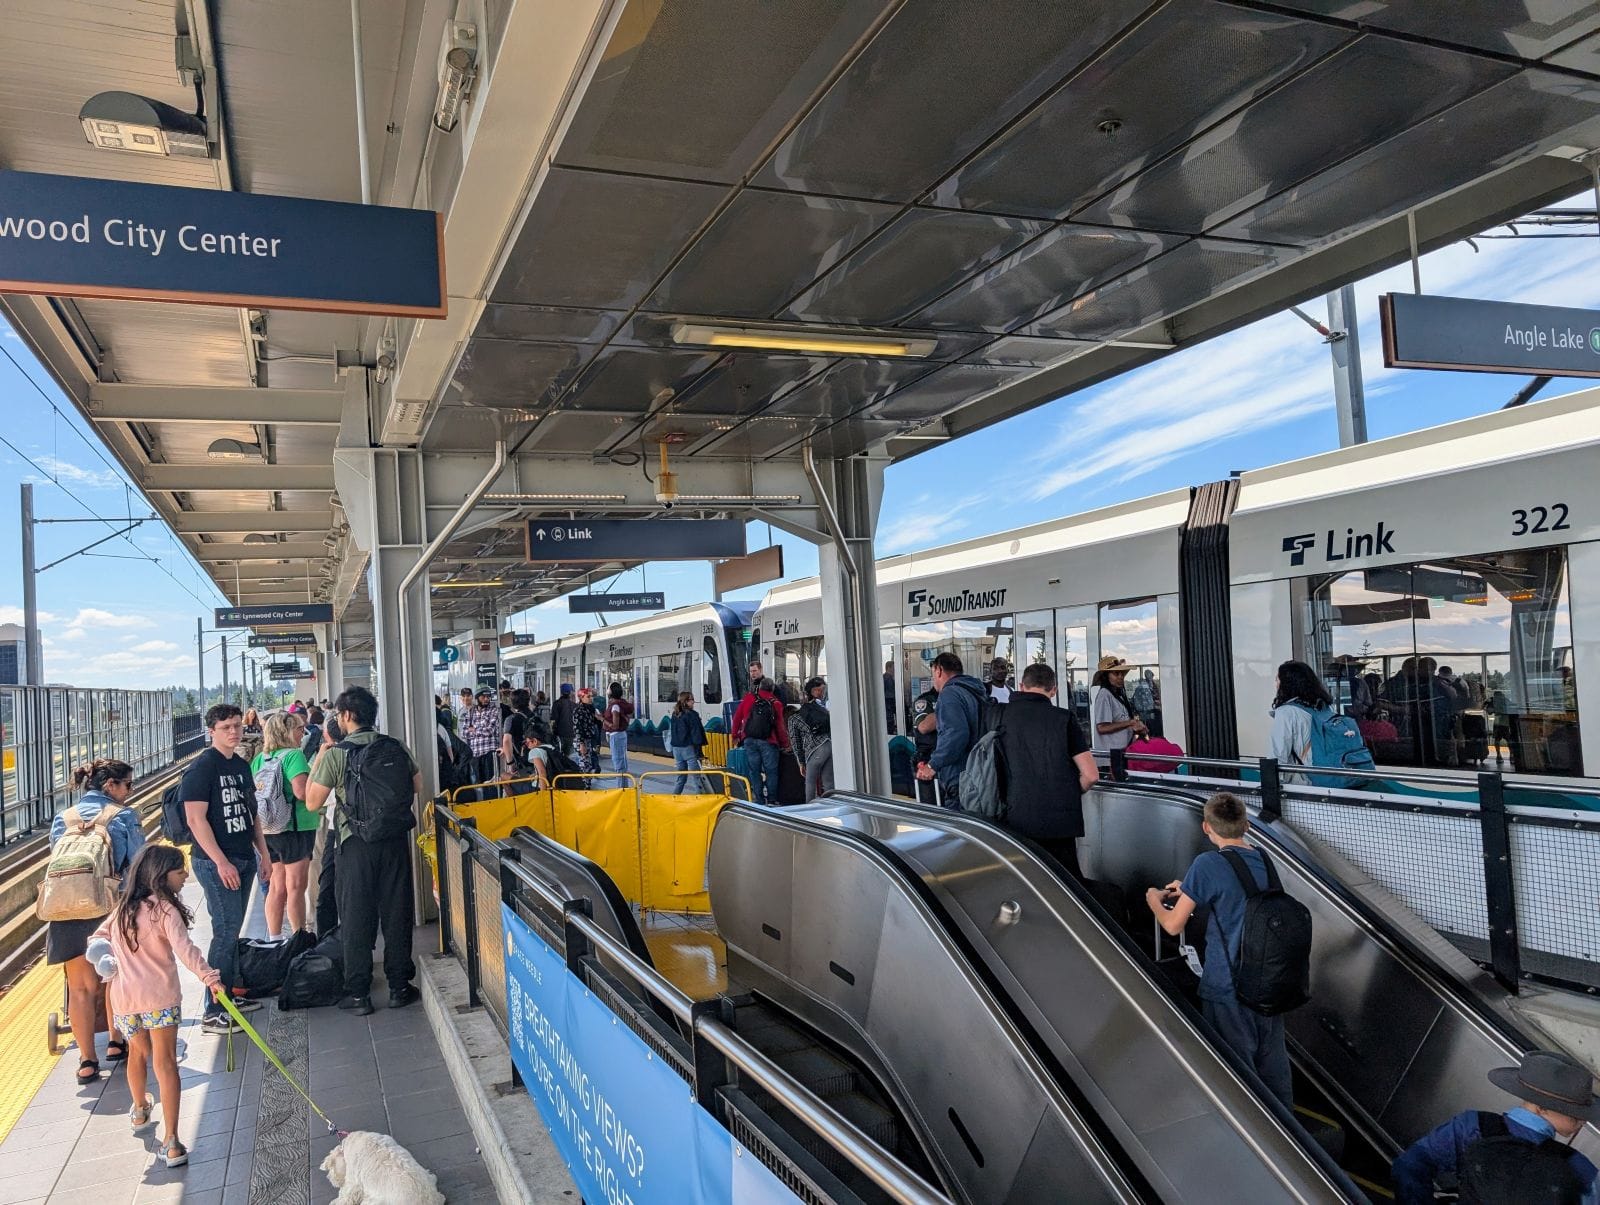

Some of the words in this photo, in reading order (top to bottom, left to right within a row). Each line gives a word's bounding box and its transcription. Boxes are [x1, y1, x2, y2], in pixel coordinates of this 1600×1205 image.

[0, 215, 90, 243] wood
[103, 219, 166, 256] City
[178, 225, 281, 258] Center
[1504, 324, 1547, 351] Angle
[1552, 327, 1584, 350] Lake
[1511, 502, 1571, 536] 322
[568, 528, 593, 541] Link
[1326, 521, 1396, 562] Link
[783, 617, 799, 634] Link
[223, 805, 232, 817] IF
[225, 816, 247, 833] TSA
[524, 991, 591, 1111] BREATHTAKING
[592, 1085, 644, 1189] VIEWS?
[555, 1084, 570, 1133] ON
[571, 1107, 593, 1172] THE
